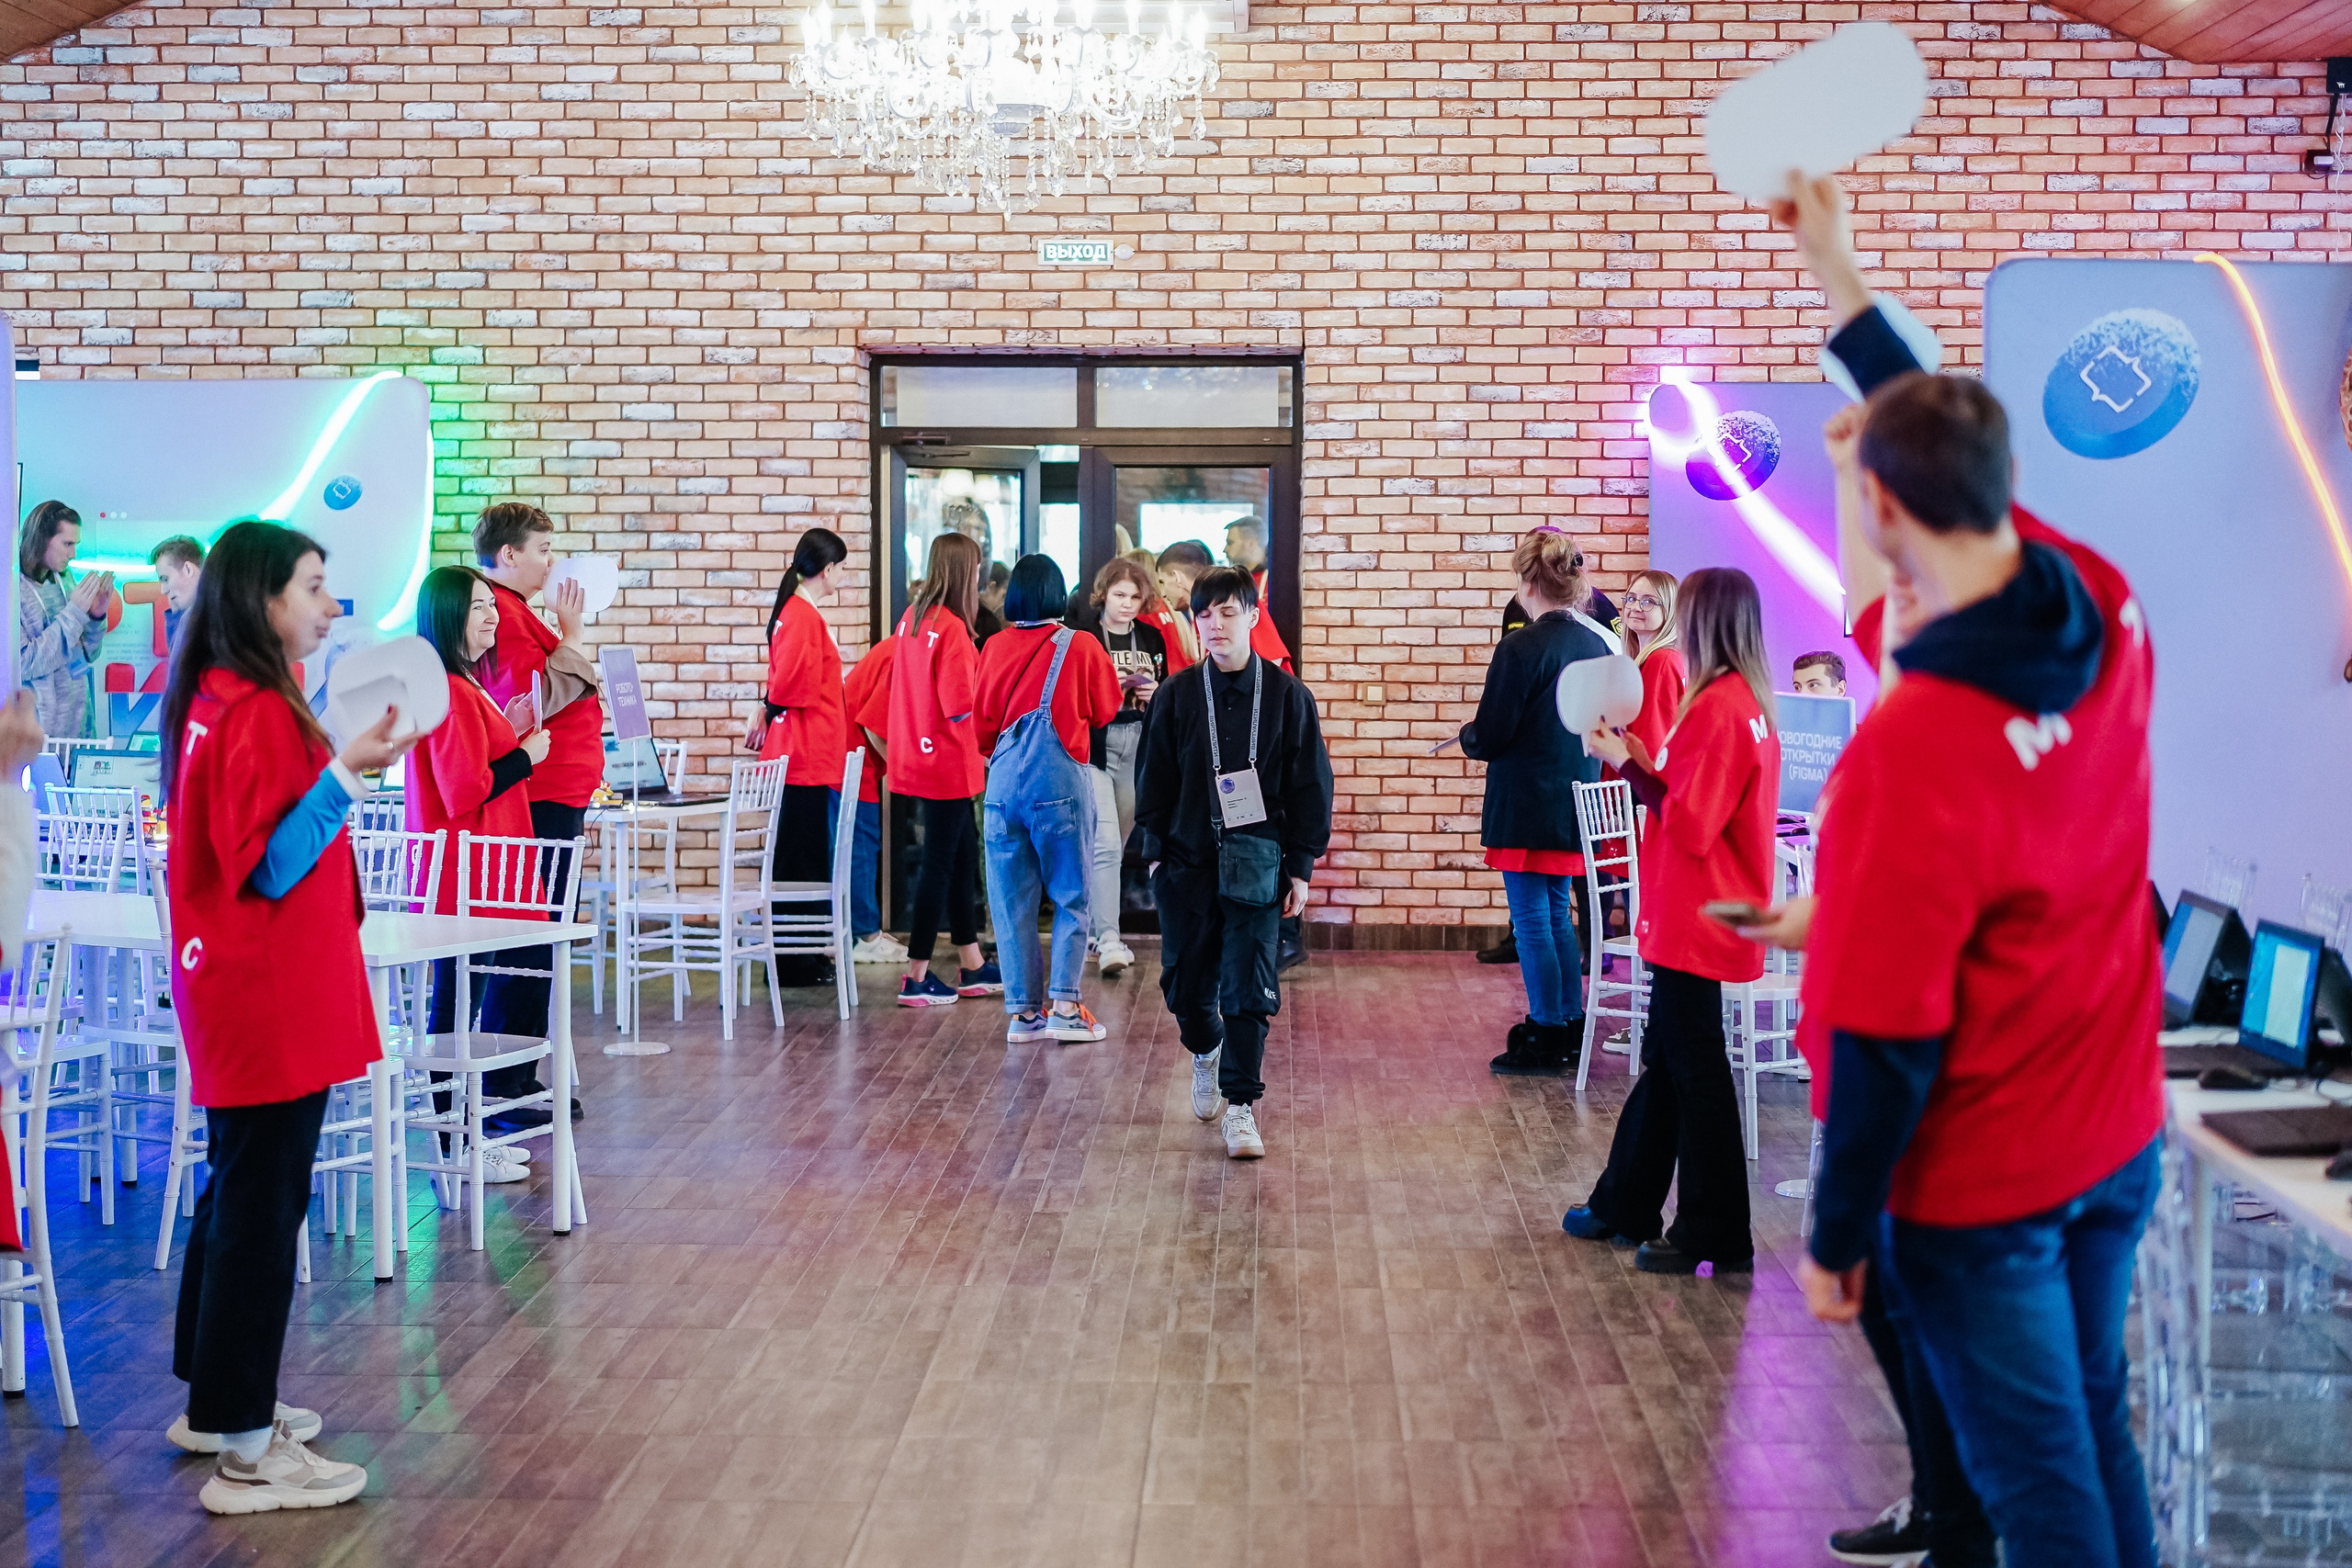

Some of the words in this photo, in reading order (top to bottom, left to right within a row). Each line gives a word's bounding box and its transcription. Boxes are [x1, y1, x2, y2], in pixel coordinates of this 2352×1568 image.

[1046, 244, 1106, 259] ВЫХОД
[617, 694, 639, 706] ТЕХНИКА
[1777, 730, 1842, 750] ОВОГОДНИЕ
[1781, 748, 1835, 766] ОТКРЫТКИ
[1789, 764, 1827, 784] (FIGMA)
